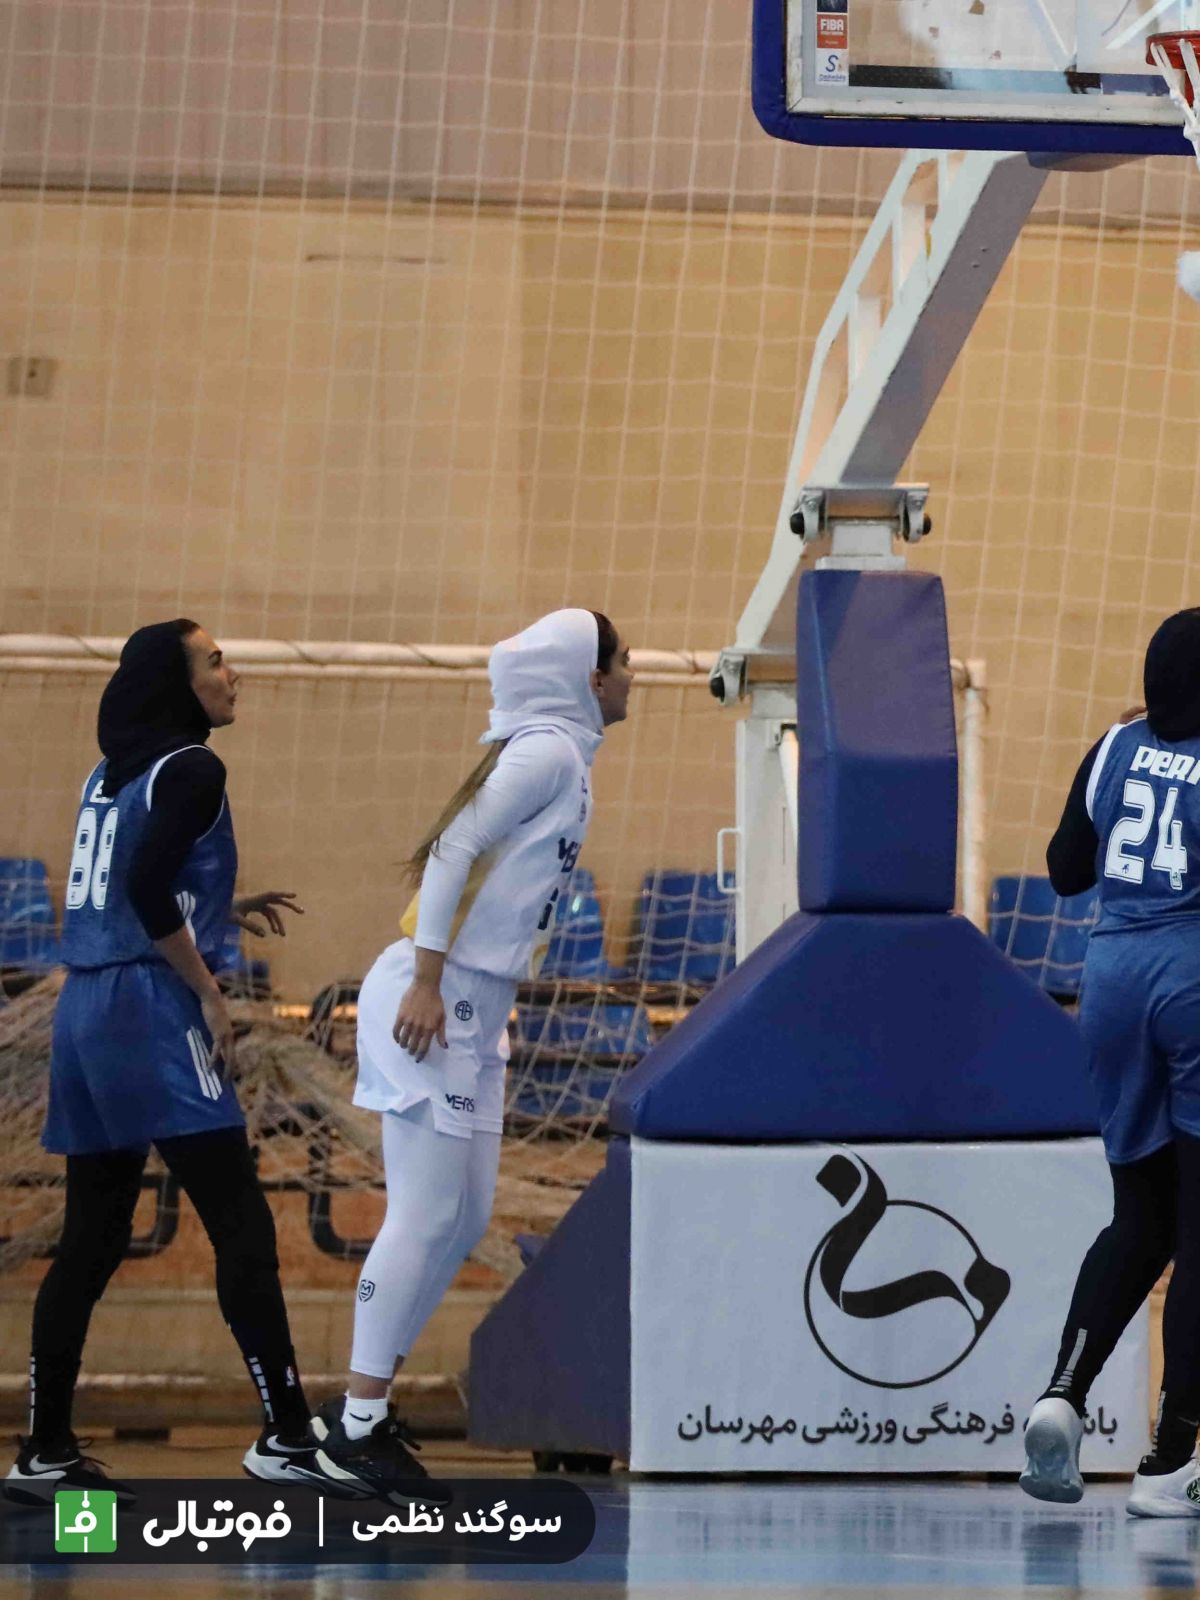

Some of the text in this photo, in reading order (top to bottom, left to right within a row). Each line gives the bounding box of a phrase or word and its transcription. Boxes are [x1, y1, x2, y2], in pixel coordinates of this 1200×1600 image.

[820, 18, 844, 31] FIBA
[1104, 778, 1188, 891] 24
[65, 806, 119, 910] 88
[677, 1404, 797, 1444] مهرسان
[801, 1407, 898, 1444] ورزشی
[902, 1402, 1015, 1444] فرهنگی
